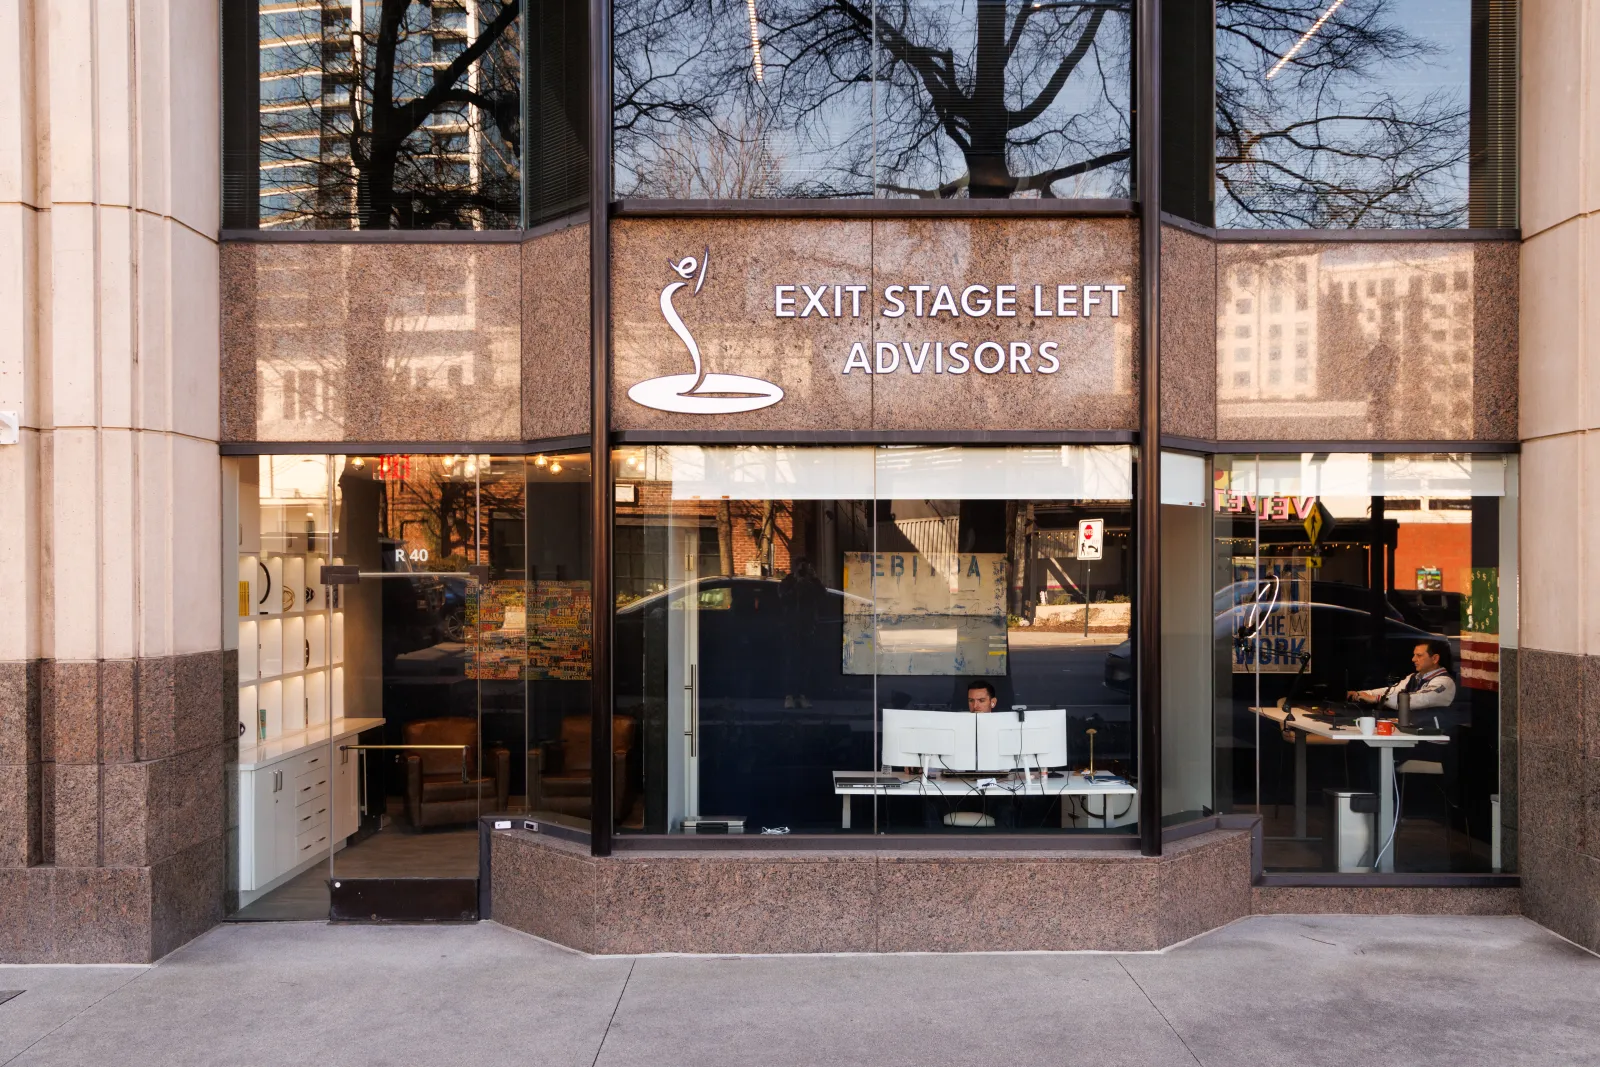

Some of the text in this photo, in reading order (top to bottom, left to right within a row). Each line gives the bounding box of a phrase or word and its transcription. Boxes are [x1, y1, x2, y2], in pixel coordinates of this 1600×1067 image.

[775, 284, 1126, 317] EXIT STAGE LEFT
[842, 341, 1060, 374] ADVISORS
[395, 549, 428, 562] R 40
[870, 555, 981, 577] EBIA
[1233, 638, 1307, 665] WORK
